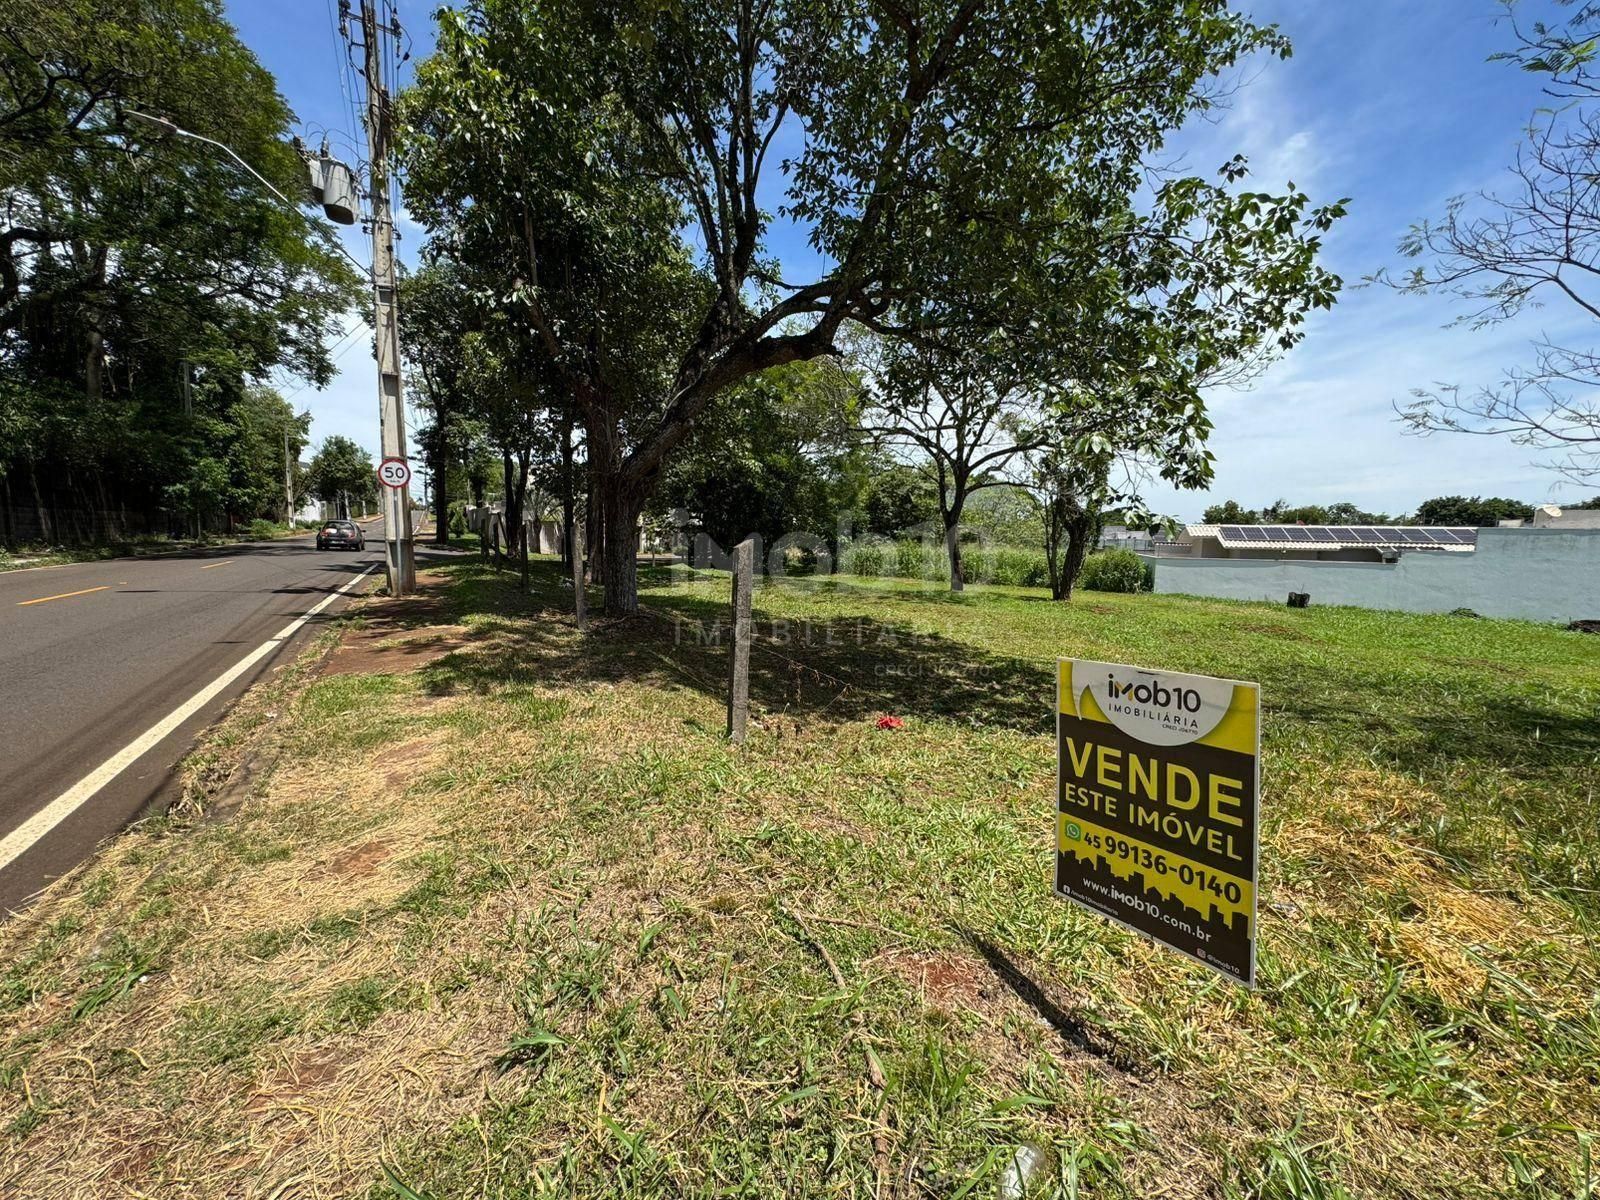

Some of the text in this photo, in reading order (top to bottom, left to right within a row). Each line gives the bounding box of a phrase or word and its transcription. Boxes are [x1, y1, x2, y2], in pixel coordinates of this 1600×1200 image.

[385, 466, 405, 479] 50
[1108, 702, 1199, 729] IMOBILIÁRIA
[1065, 736, 1243, 828] VENDE
[1065, 782, 1243, 862] ESTE IMÓVEL
[1083, 831, 1242, 904] 45 99136-0140
